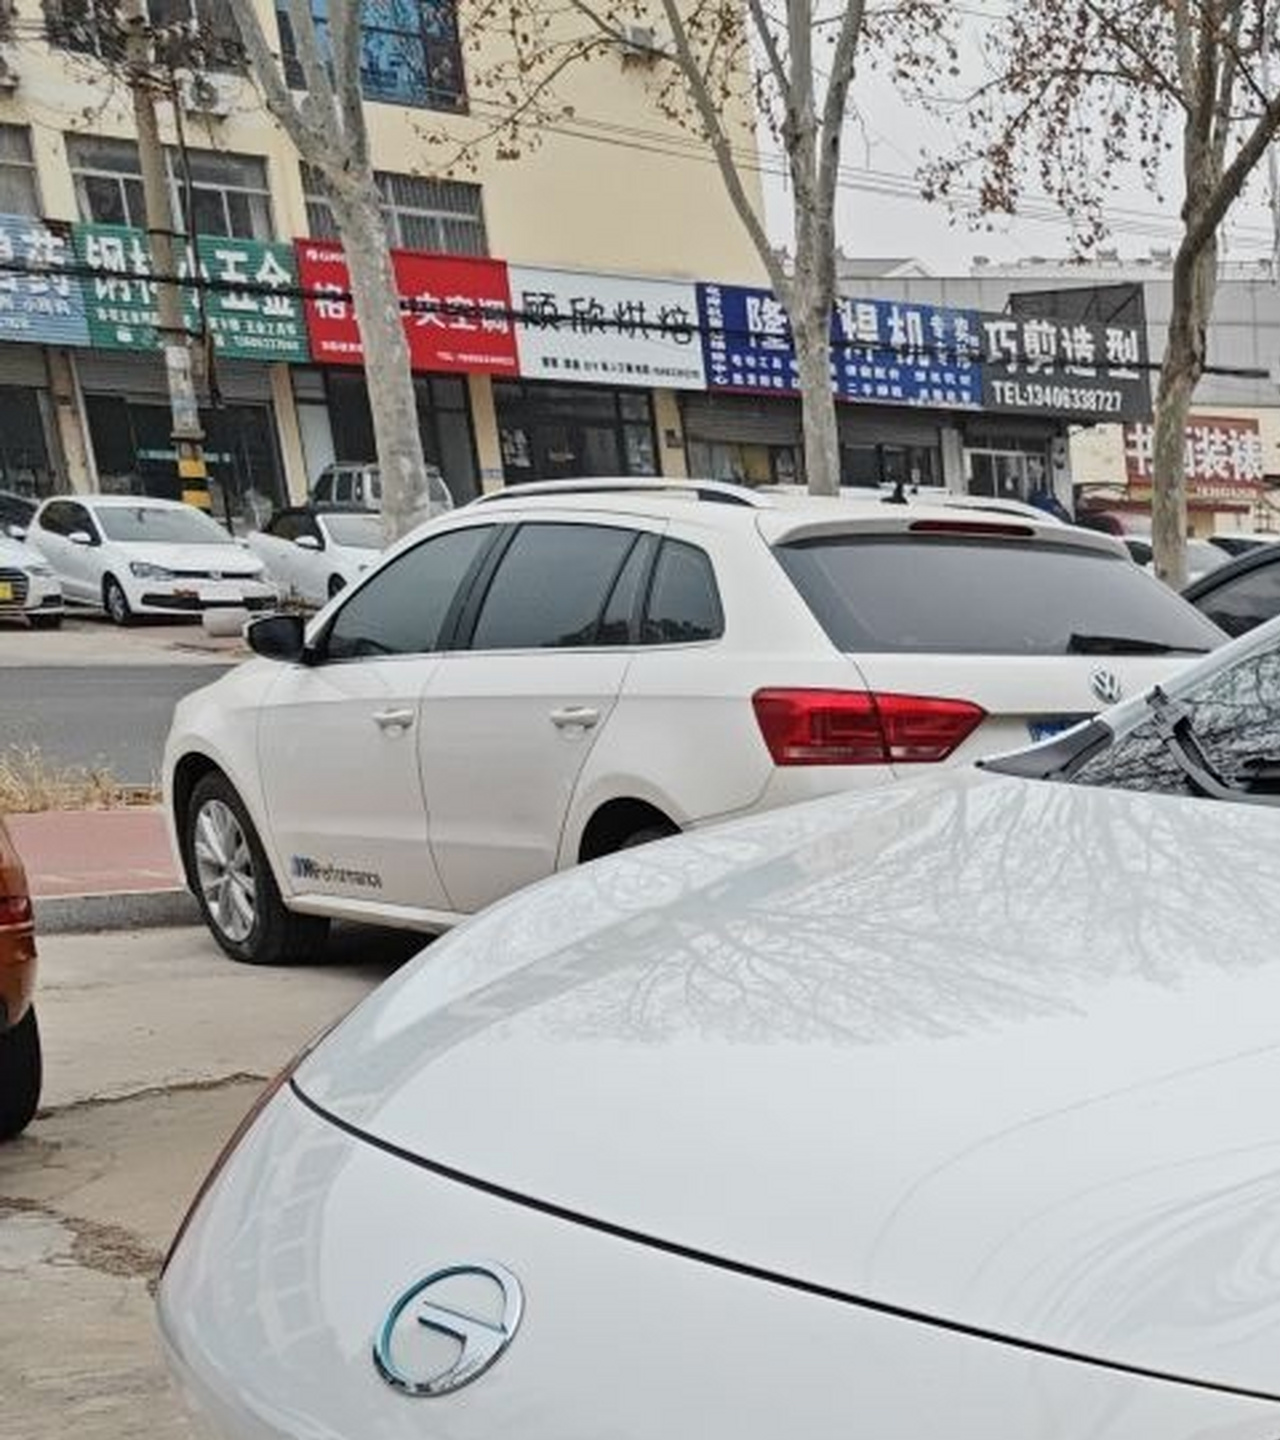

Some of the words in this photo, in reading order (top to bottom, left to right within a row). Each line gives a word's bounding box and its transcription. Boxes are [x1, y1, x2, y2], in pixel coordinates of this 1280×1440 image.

[313, 282, 509, 334] 格央空调
[983, 319, 1140, 379] 巧剪造型
[1126, 422, 1263, 481] 书装裱
